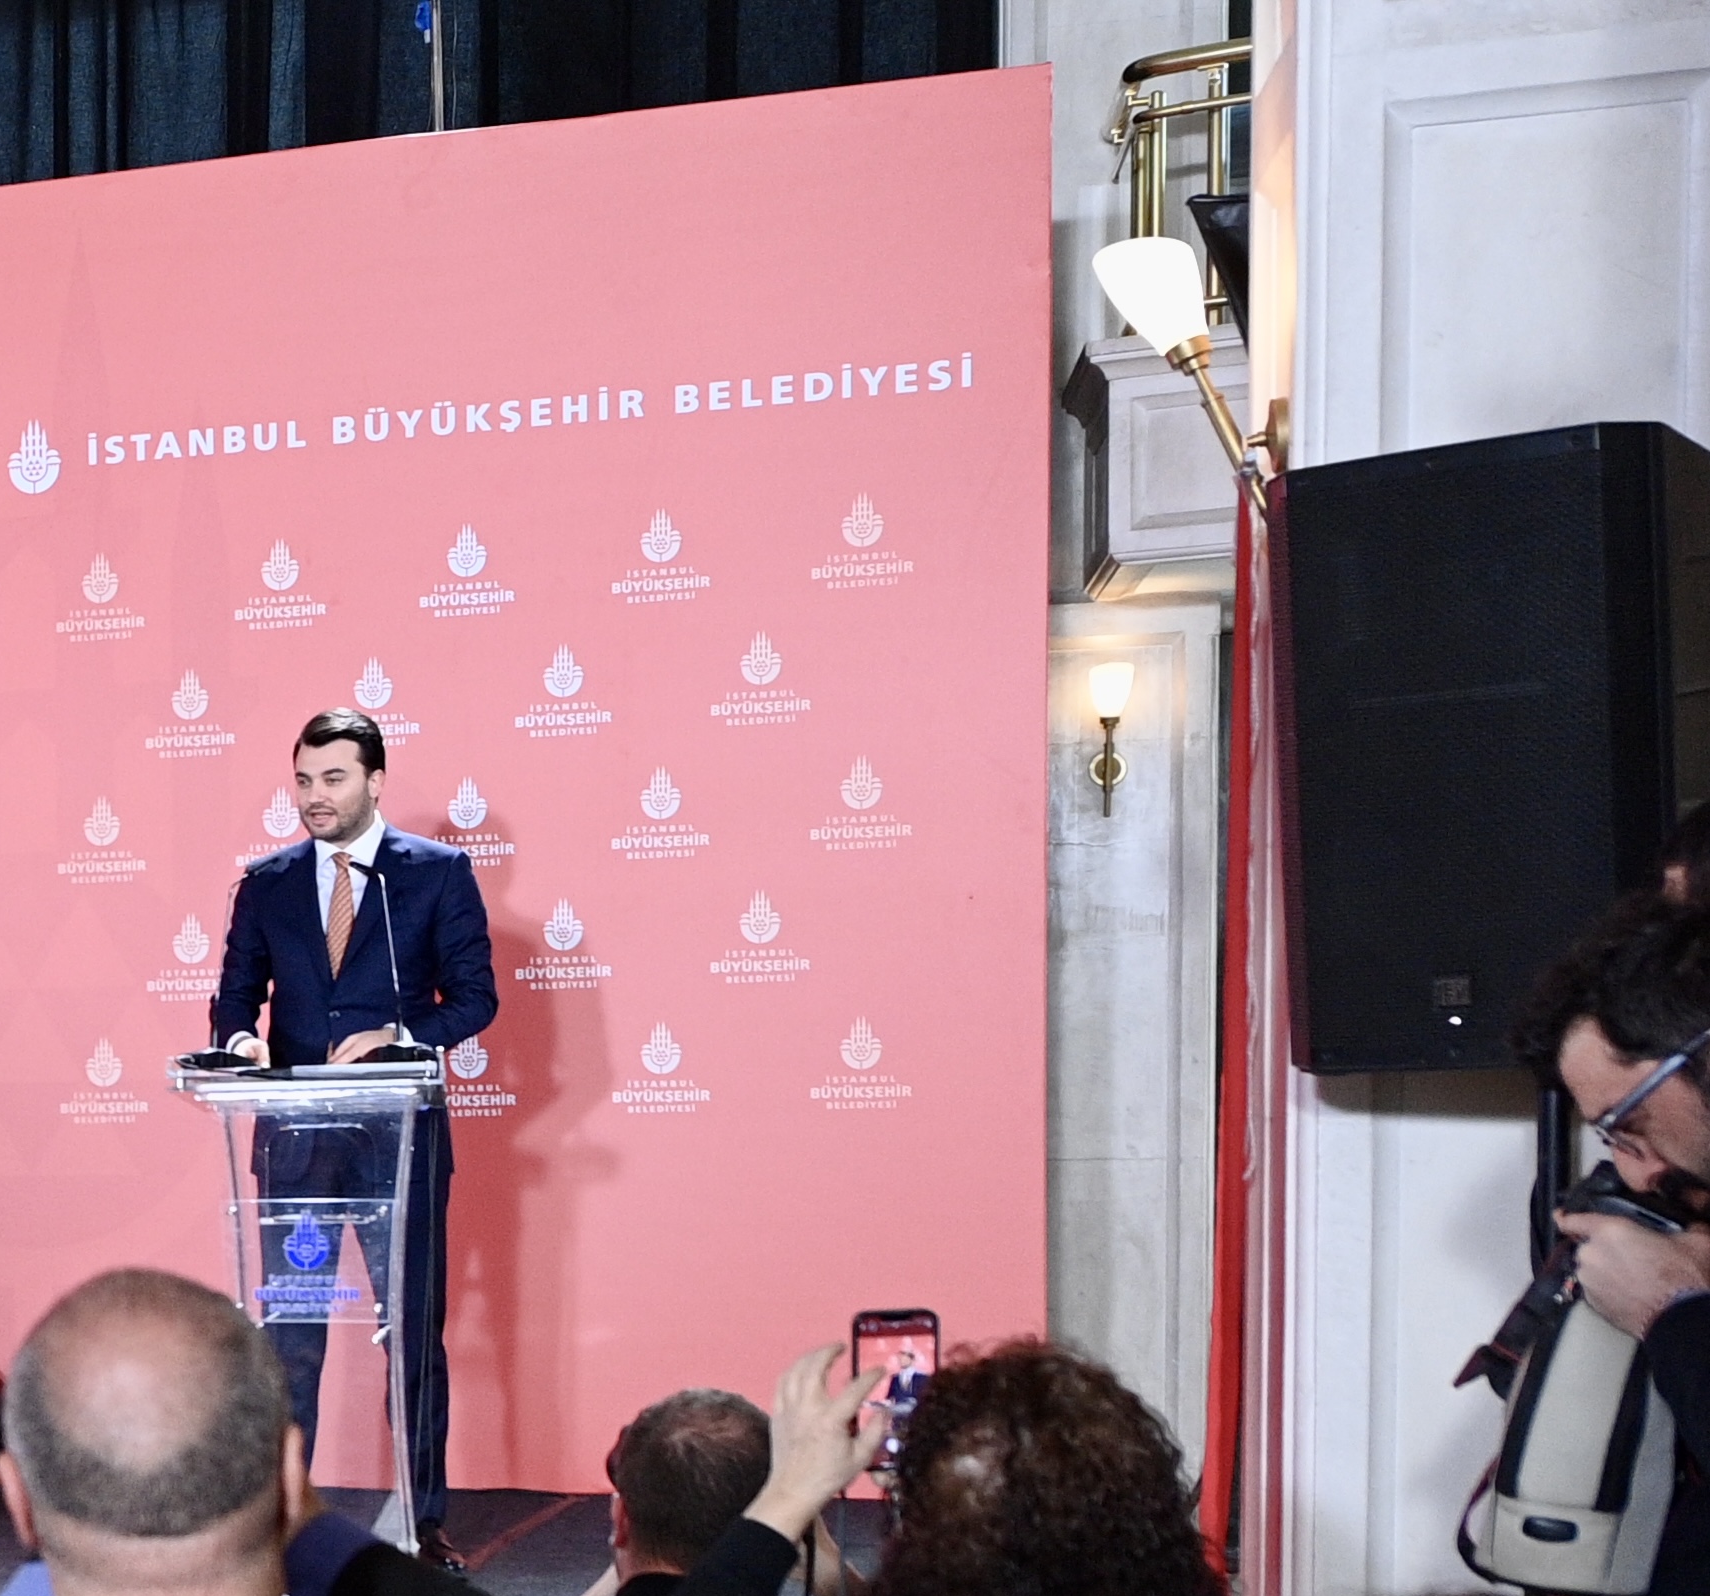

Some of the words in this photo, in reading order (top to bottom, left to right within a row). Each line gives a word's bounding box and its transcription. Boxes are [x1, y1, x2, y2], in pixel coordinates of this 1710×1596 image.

[87, 420, 307, 466] İSTANBUL
[331, 386, 645, 446] BÜYÜKŞEHİR
[674, 351, 973, 414] BELEDİYESİ
[811, 559, 914, 580] BÜYÜKŞEHİR
[611, 574, 711, 595] BÜYÜKŞEHİR
[419, 588, 515, 608] BÜYÜKŞEHİR
[234, 602, 327, 621] BÜYÜKŞEHİR
[56, 615, 145, 633] BÜYÜKŞEHİR
[710, 697, 811, 717] BÜYÜKŞEHİR
[514, 709, 612, 728] BÜYÜKŞEHİR
[145, 732, 236, 749] BÜYÜKŞEHİR
[809, 822, 912, 841] BÜYÜKŞEHİR
[611, 832, 710, 850] BÜYÜKŞEHİR
[57, 858, 147, 875] BÜYÜKŞEHİR
[514, 964, 612, 981] BÜYÜKŞEHİR
[710, 956, 810, 974] BÜYÜKŞEHİR
[612, 1087, 711, 1104] BÜYÜKŞEHİR
[810, 1083, 912, 1100] BÜYÜKŞEHİR
[60, 1100, 149, 1114] BÜYÜKŞEHİR
